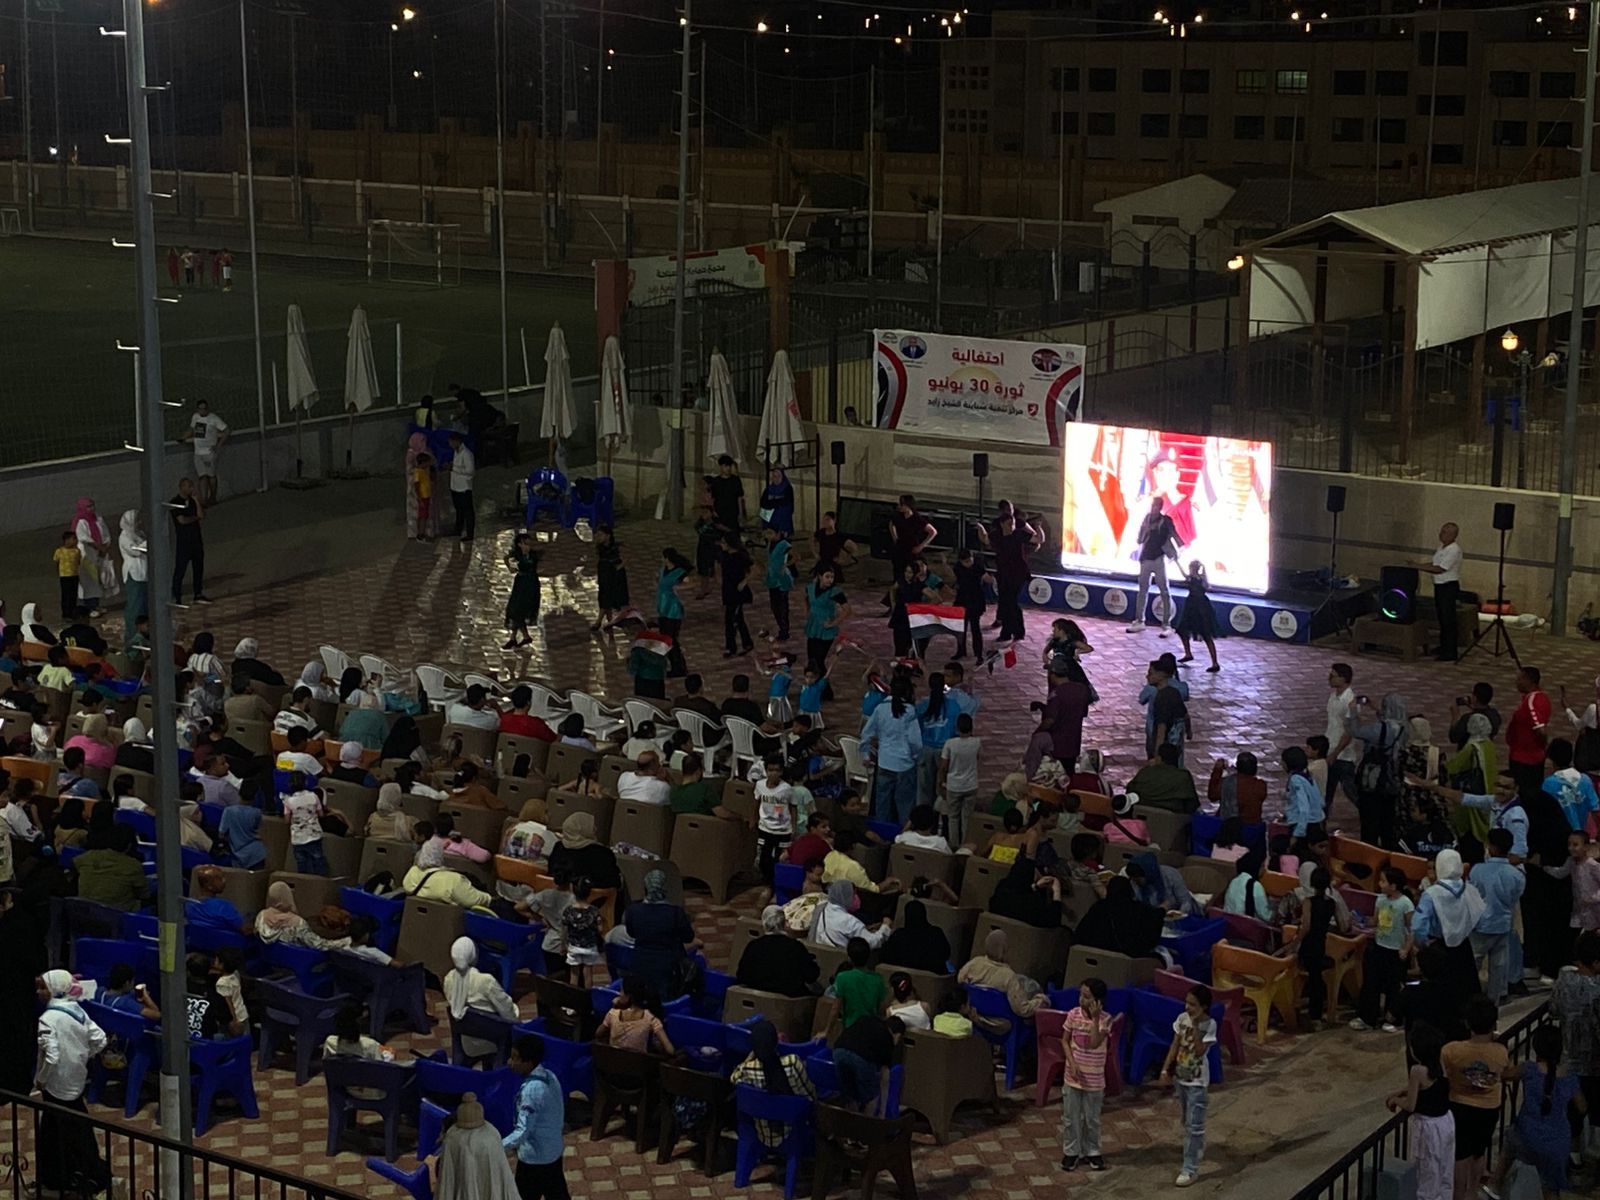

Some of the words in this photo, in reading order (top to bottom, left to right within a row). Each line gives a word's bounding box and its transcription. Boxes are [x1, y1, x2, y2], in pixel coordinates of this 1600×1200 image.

[952, 347, 1004, 366] احتفالية
[928, 376, 963, 395] يونيو
[969, 378, 989, 393] 30
[994, 381, 1025, 400] ثورة
[1008, 405, 1024, 415] مركز
